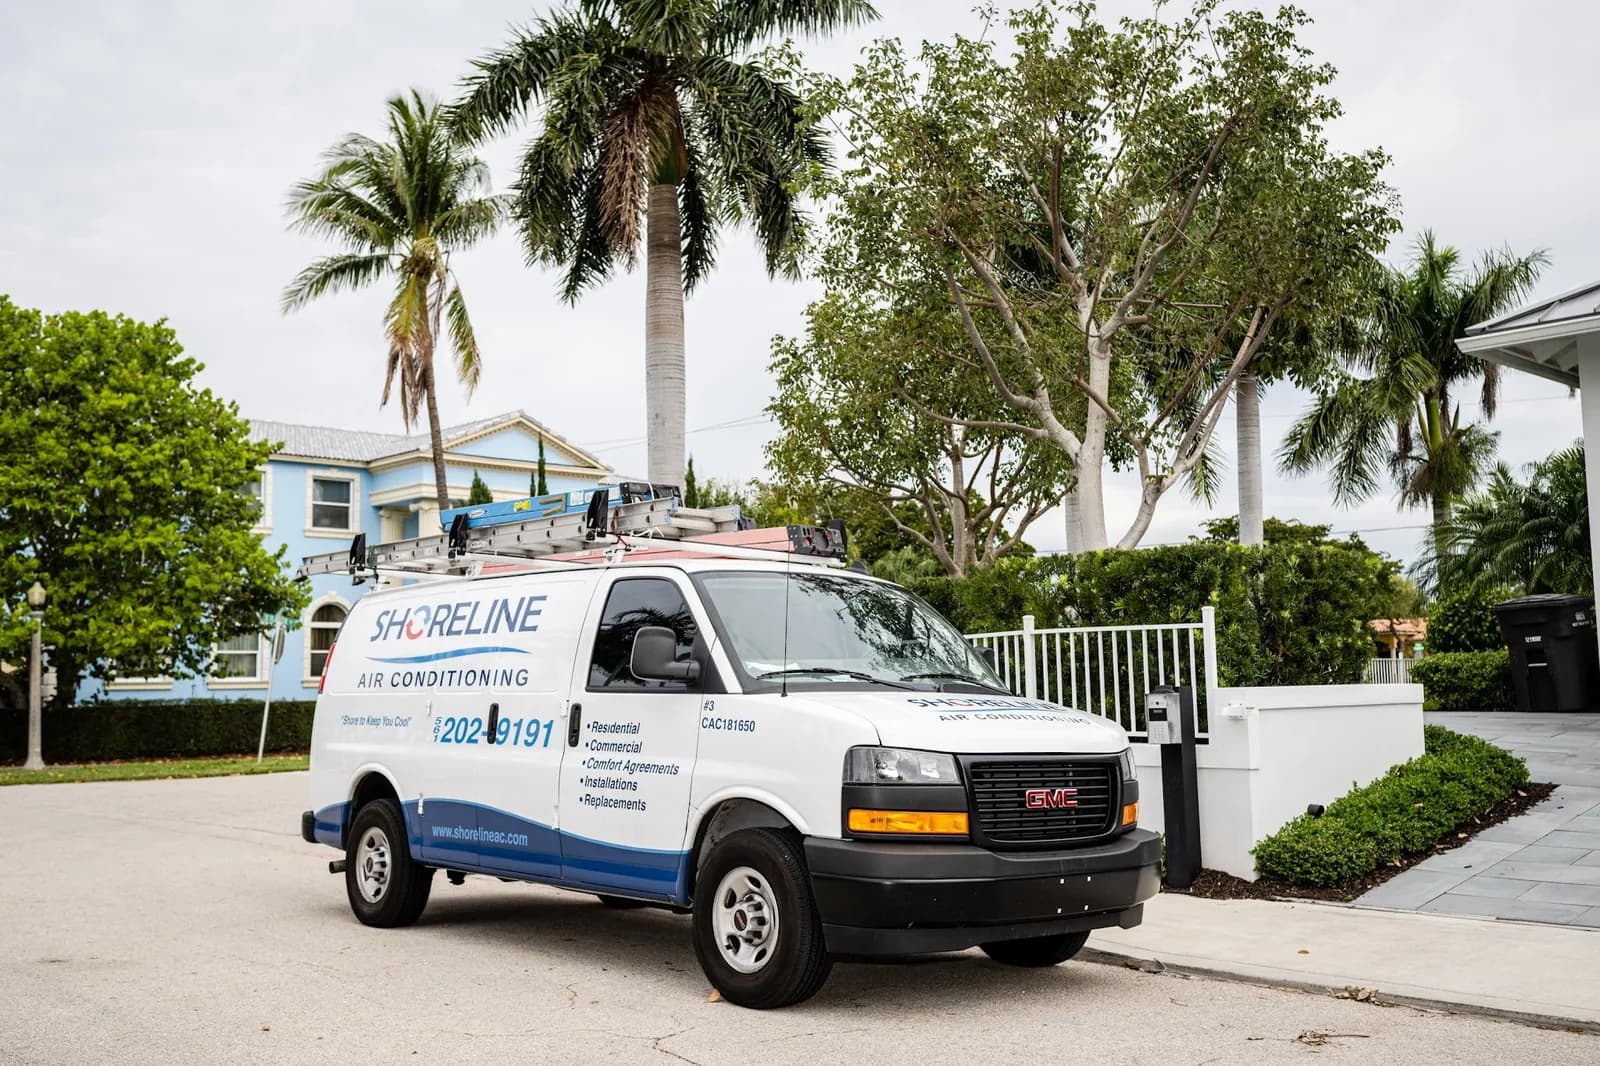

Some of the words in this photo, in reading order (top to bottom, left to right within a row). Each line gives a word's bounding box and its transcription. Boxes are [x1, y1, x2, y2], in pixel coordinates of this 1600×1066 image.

[370, 595, 548, 642] SHORELINE
[357, 672, 384, 689] AIR
[390, 668, 529, 688] CONDITIONING
[703, 701, 715, 712] #3
[382, 715, 394, 727] You
[701, 717, 756, 733] CAC181650
[938, 714, 967, 722] AIR
[591, 721, 641, 735] Residential
[590, 739, 643, 754] Commercial
[586, 757, 623, 771] Comfort
[623, 760, 680, 776] Agreements
[584, 777, 639, 792] Installations
[584, 794, 647, 812] Replacements
[1025, 788, 1079, 809] GMC
[431, 824, 529, 847] www.shorelineac.com
